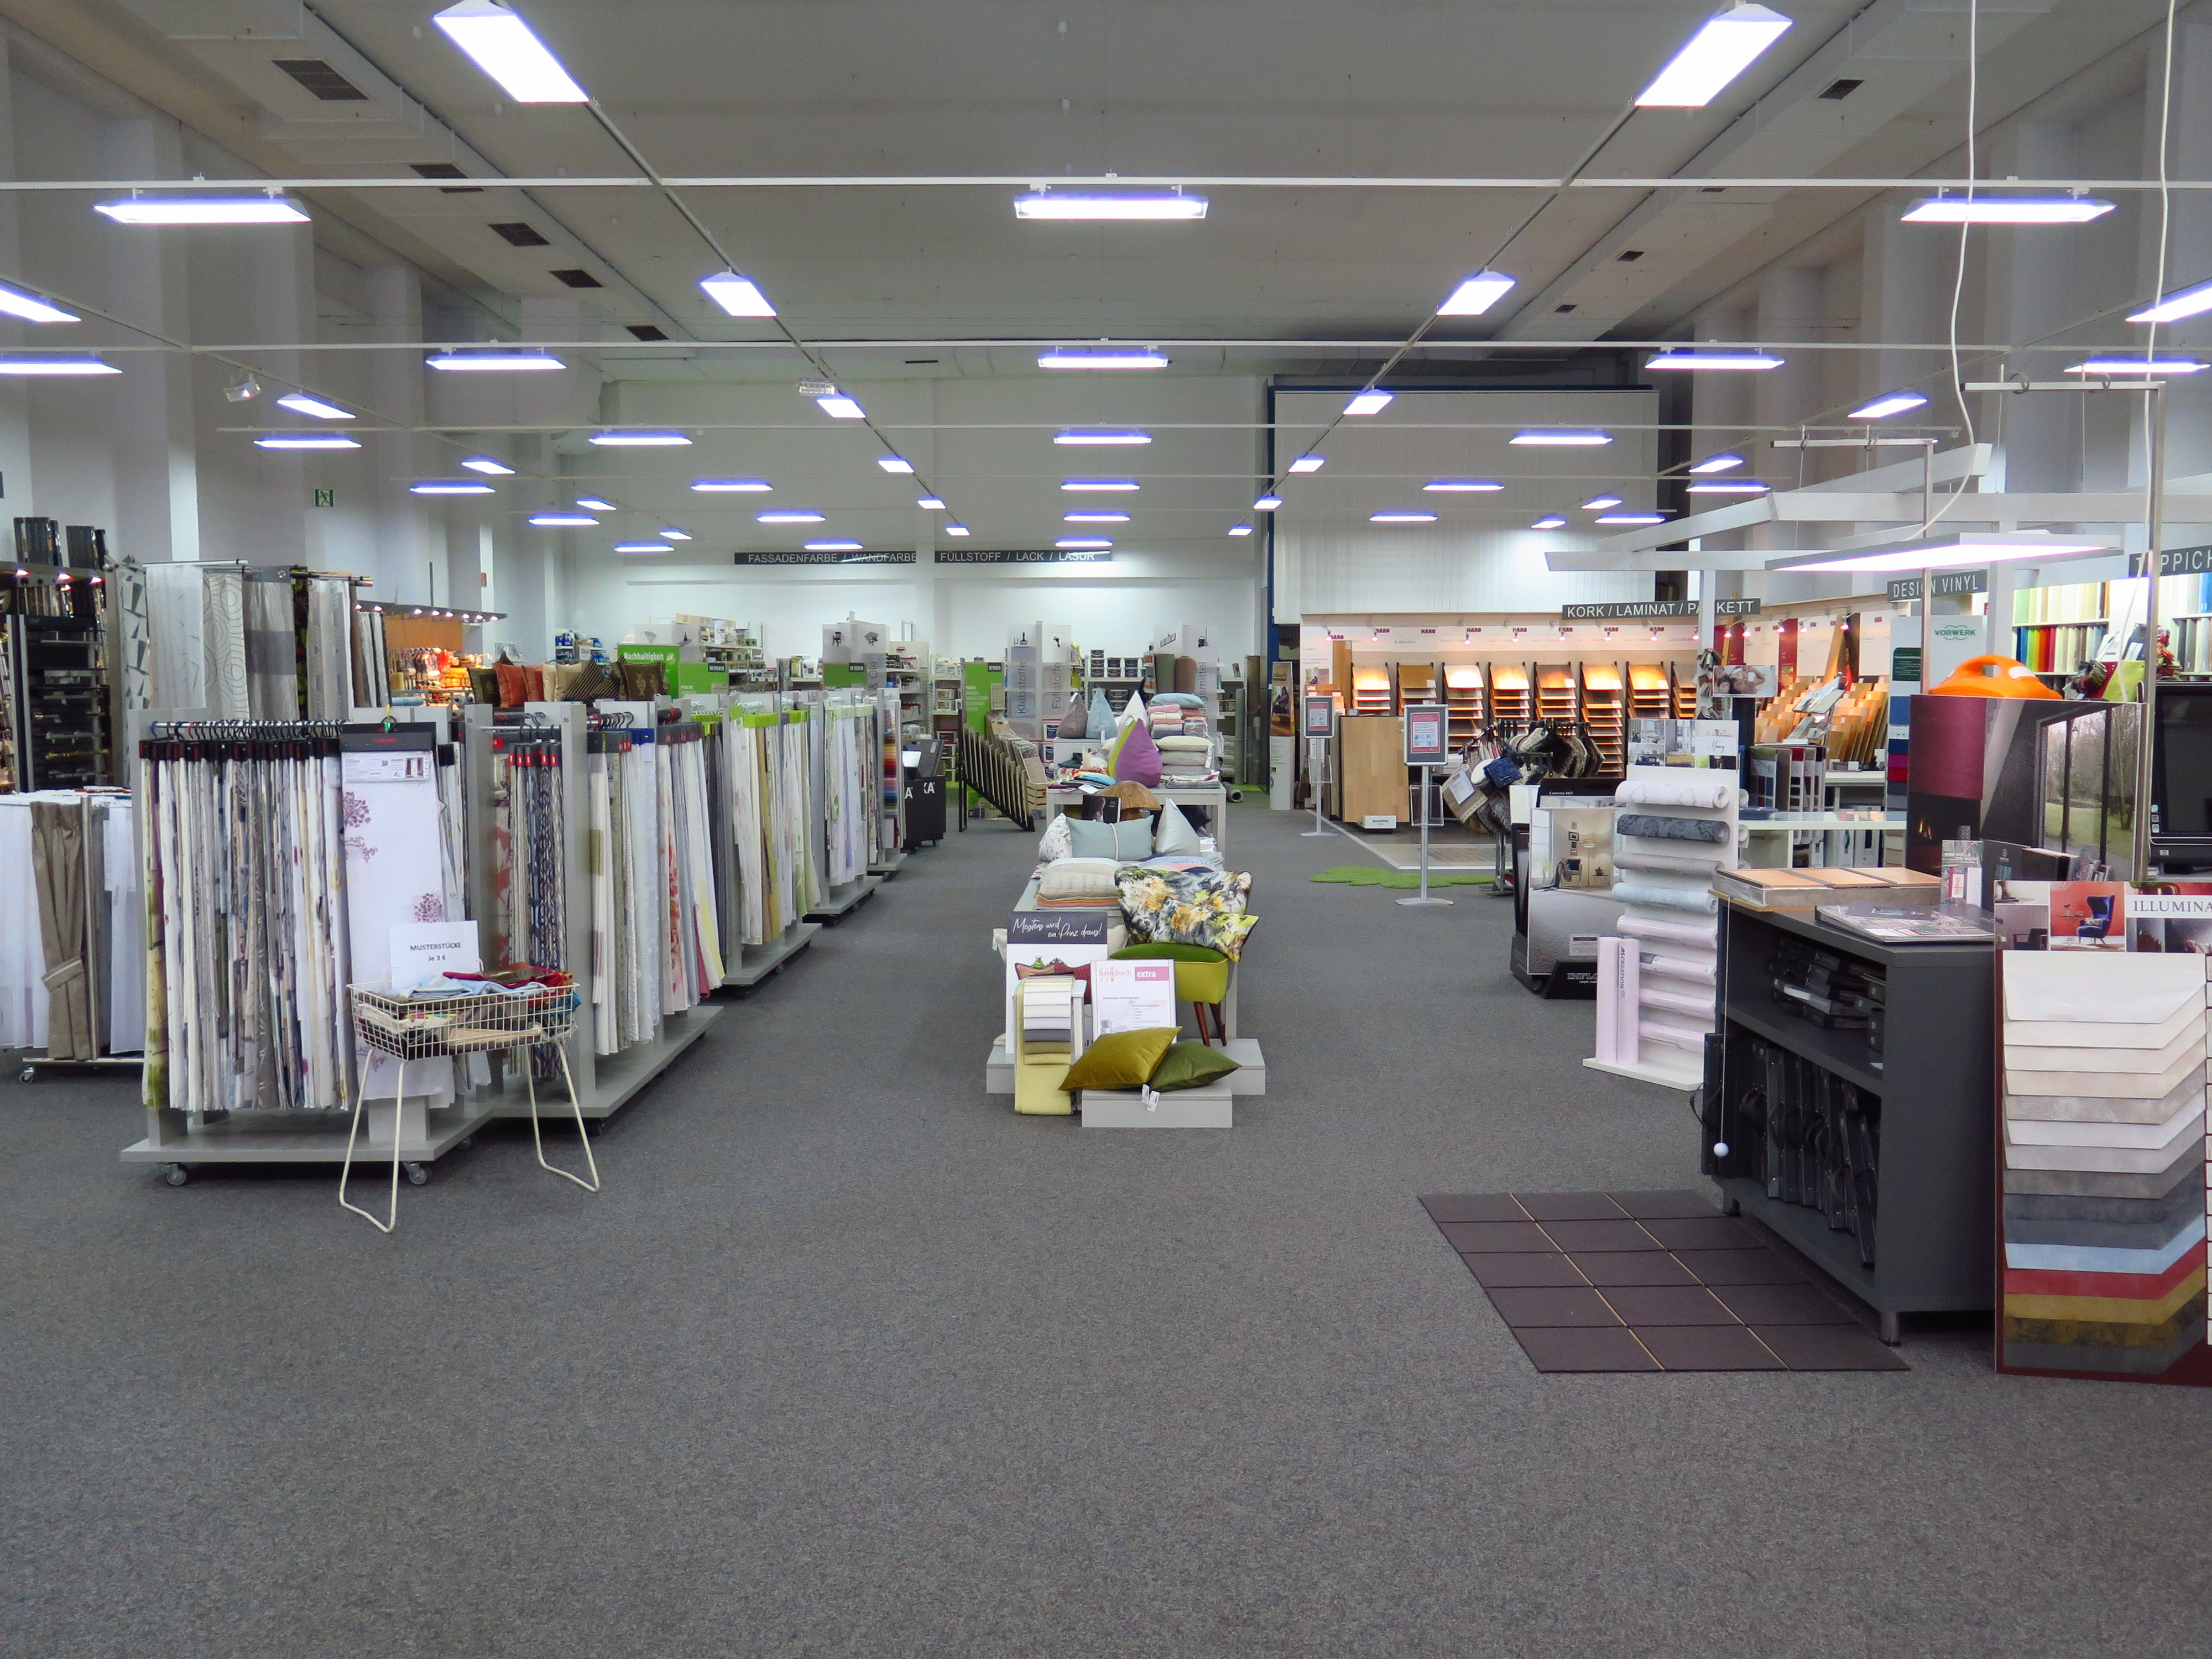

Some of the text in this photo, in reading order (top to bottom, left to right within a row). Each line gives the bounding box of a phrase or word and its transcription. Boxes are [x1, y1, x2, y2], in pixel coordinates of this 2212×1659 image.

[748, 554, 837, 563] FASSADENFARBE
[941, 550, 1001, 561] FÜLLSTOFF
[1016, 552, 1045, 561] LACK
[1058, 551, 1095, 561] LASUR
[1893, 575, 1979, 598] DESIN VINYL
[1567, 605, 1604, 618] KORK
[1608, 605, 1613, 617] /
[1616, 603, 1676, 616] LAMINAT
[1679, 603, 1684, 615] /
[624, 652, 665, 661] Nachhaltigkeit
[1017, 661, 1026, 714] Klebstoffe
[2133, 900, 2212, 912] ILLUMINA
[1013, 917, 1062, 933] Meistens wird
[1058, 922, 1078, 938] Prinz
[1081, 922, 1103, 938] draus!
[409, 942, 461, 951] MUSTERSTÜCKE
[1136, 970, 1157, 978] extra
